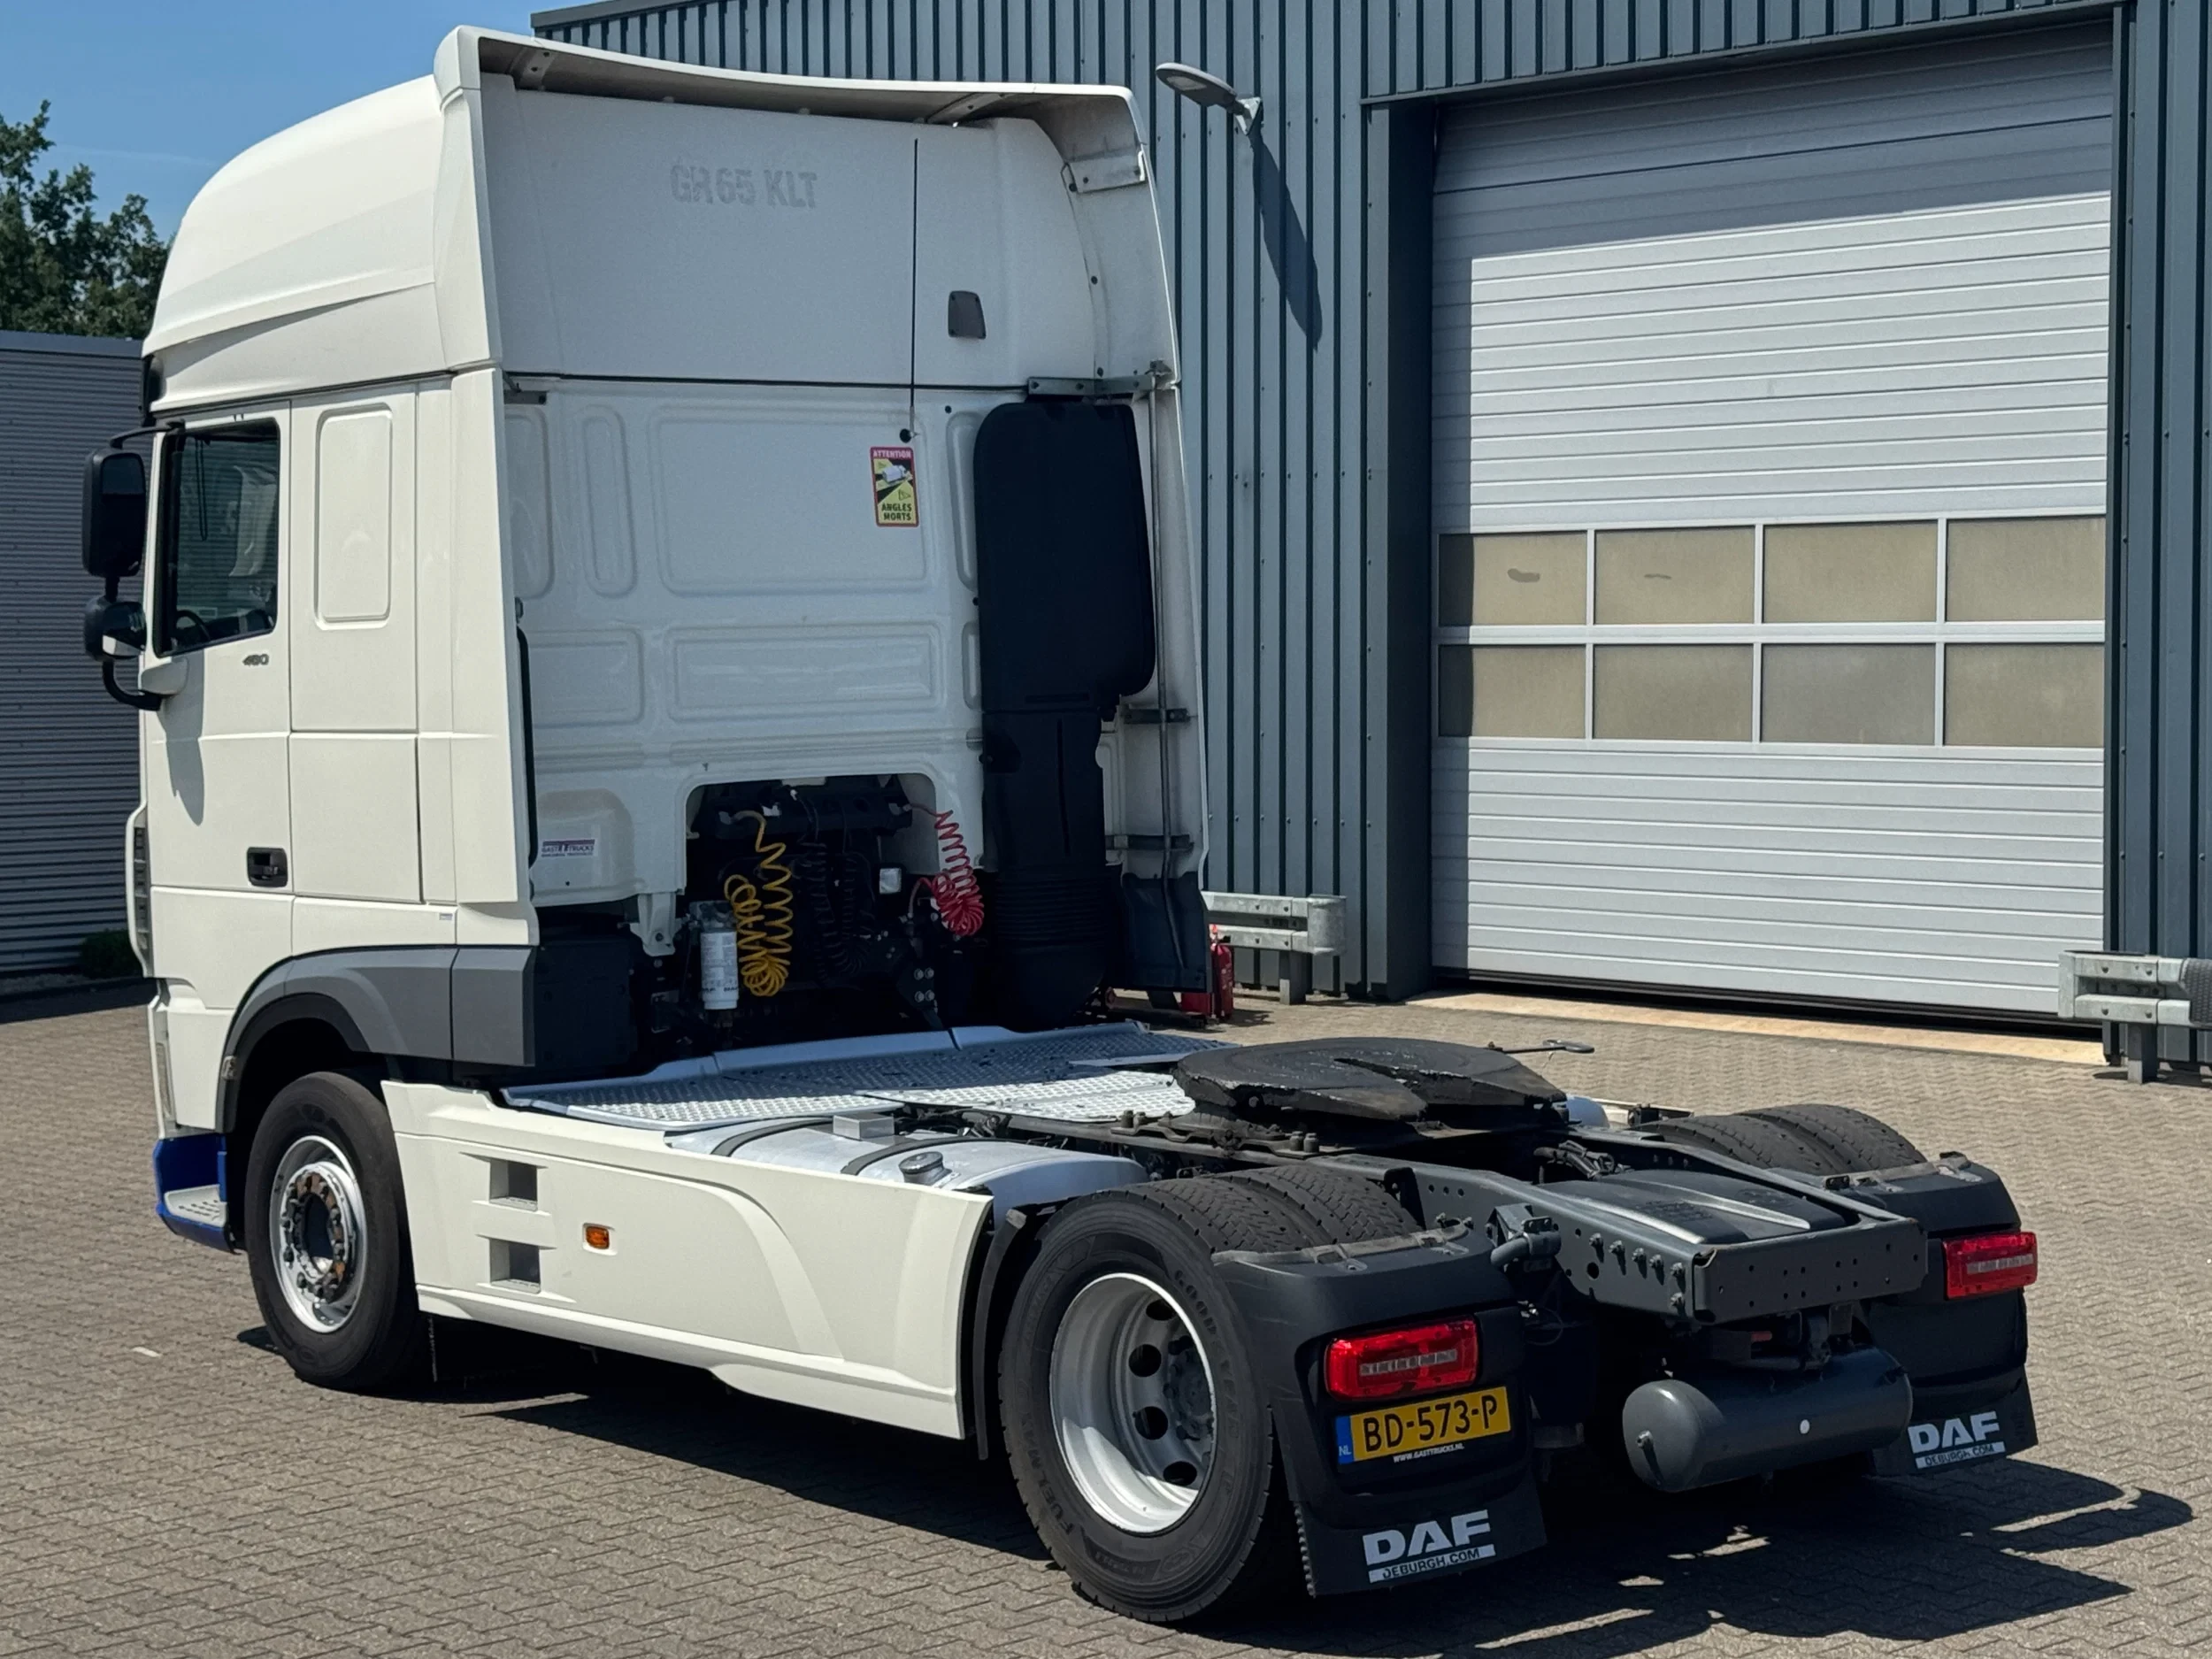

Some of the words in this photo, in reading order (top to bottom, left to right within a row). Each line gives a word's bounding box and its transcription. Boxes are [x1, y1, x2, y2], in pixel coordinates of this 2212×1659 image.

[764, 169, 818, 209] KLT
[872, 449, 911, 458] ATTENTION
[881, 503, 912, 512] ANGLES
[883, 512, 912, 521] MORTS
[1363, 1394, 1497, 1453] BD-573-P
[1908, 1410, 2000, 1454] DAF
[1339, 1445, 1352, 1455] NL
[1362, 1509, 1491, 1566] DAF
